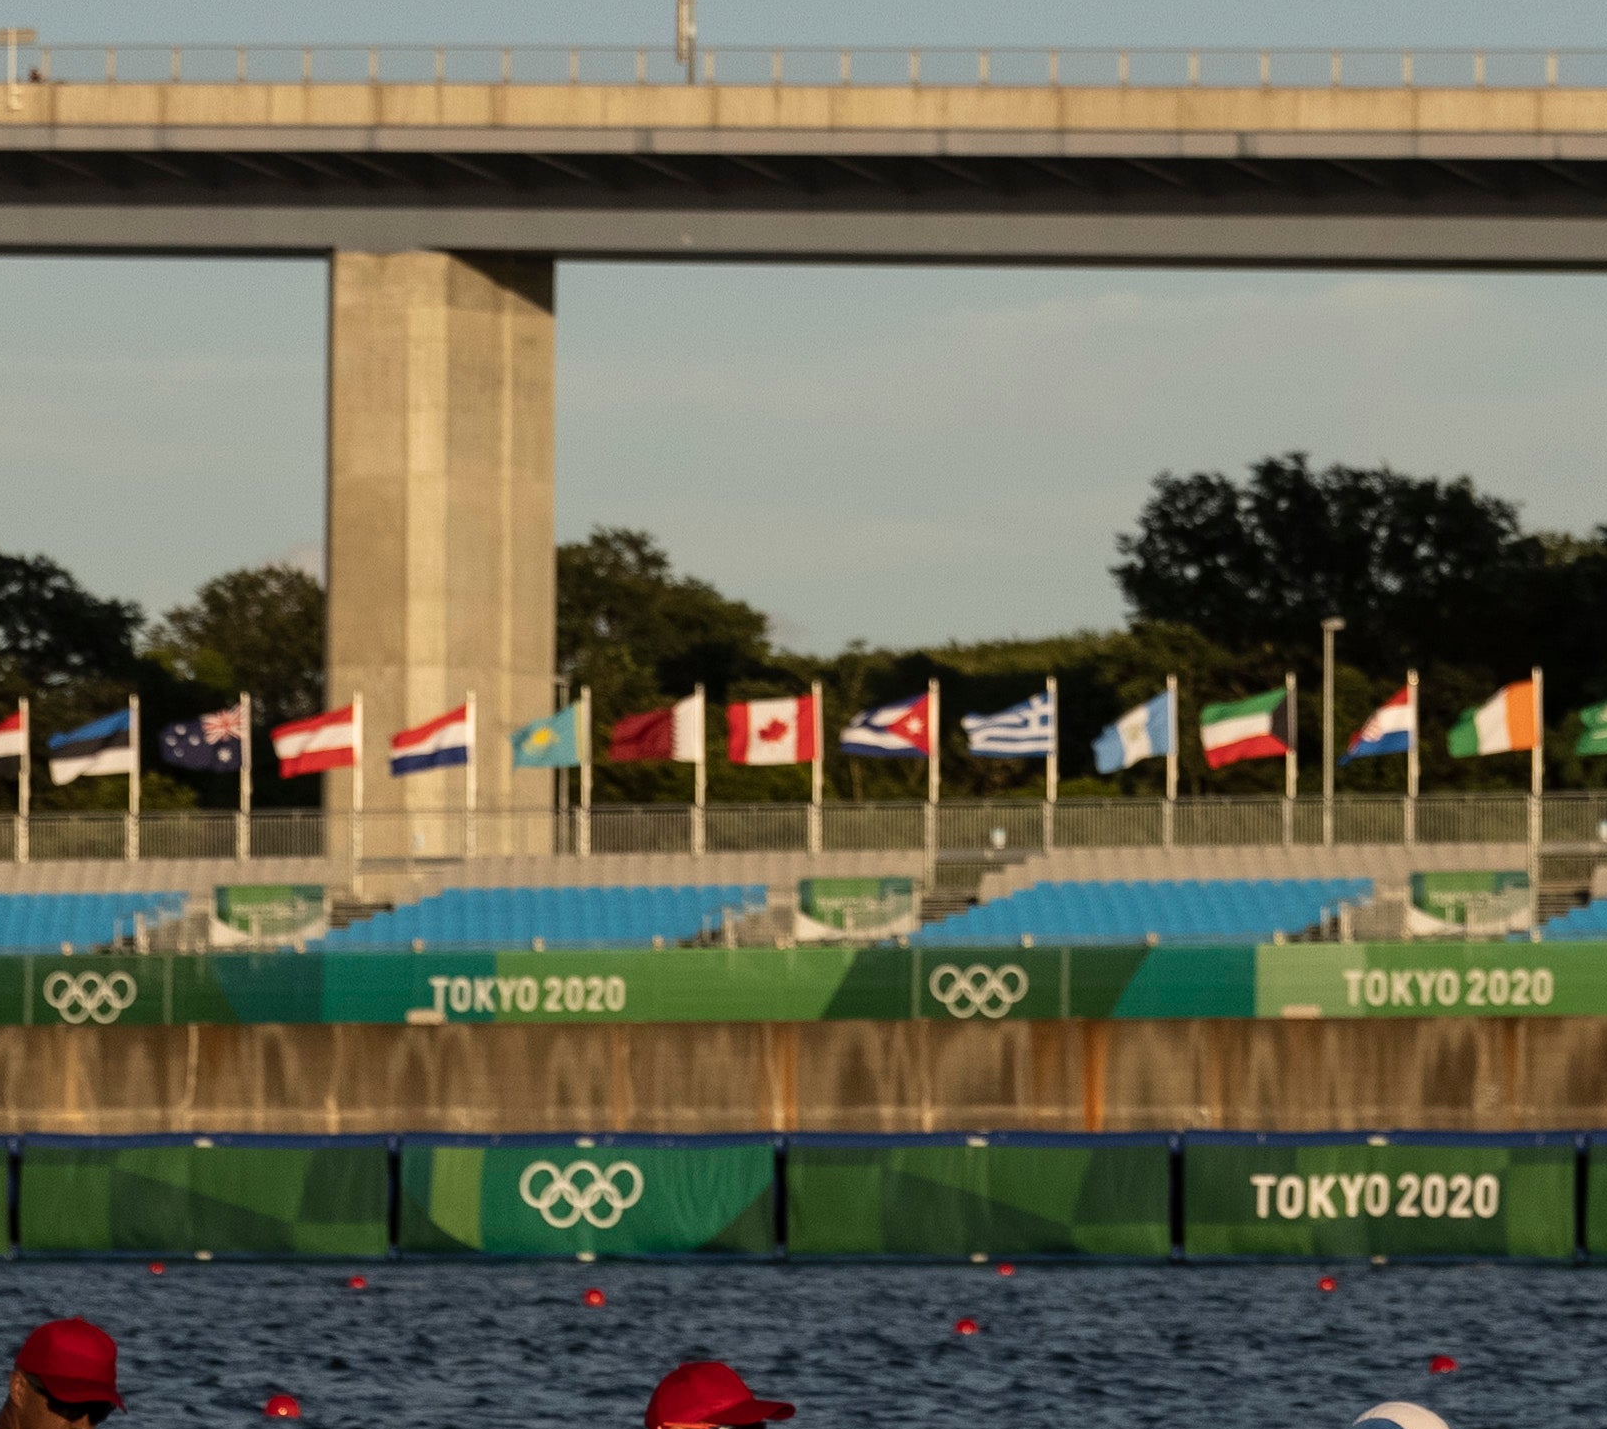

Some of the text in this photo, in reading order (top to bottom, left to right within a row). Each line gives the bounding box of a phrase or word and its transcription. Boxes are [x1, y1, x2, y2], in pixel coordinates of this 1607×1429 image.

[425, 976, 626, 1013] TOKYO 2020
[1339, 967, 1554, 1007] TOKYO 2020
[1250, 1173, 1499, 1219] TOKYO 2020
